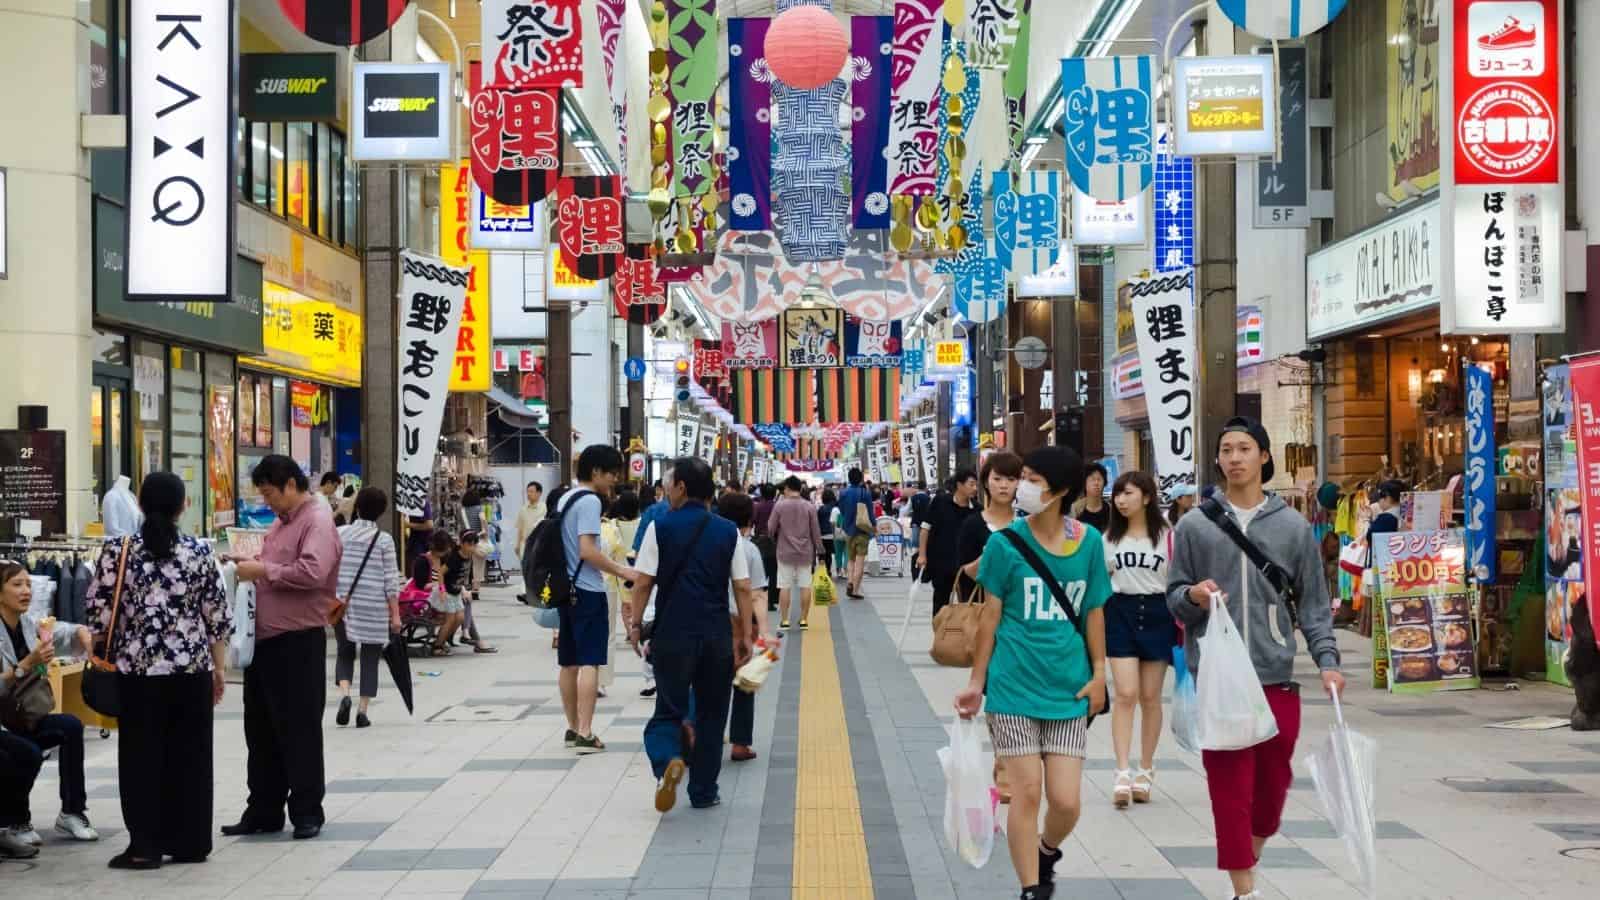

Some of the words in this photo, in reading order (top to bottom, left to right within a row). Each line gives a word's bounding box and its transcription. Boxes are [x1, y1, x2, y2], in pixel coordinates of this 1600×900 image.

[497, 5, 569, 66] 祭
[255, 78, 327, 94] SUBWAY
[368, 98, 435, 112] SUBWAY
[675, 102, 712, 178] 狸祭
[894, 99, 933, 176] 狸祭
[513, 156, 554, 167] まつり
[1356, 219, 1431, 301] MALAIKA
[1484, 191, 1507, 322] ぽんぽこ亭
[313, 311, 334, 341] 薬
[790, 348, 834, 365] 狸まつり
[937, 343, 961, 353] ABC
[937, 354, 962, 364] MART
[1146, 304, 1193, 461] 狸まつり
[20, 447, 34, 459] 2F
[1388, 532, 1449, 556] ランチ
[1115, 551, 1164, 572] JOLT
